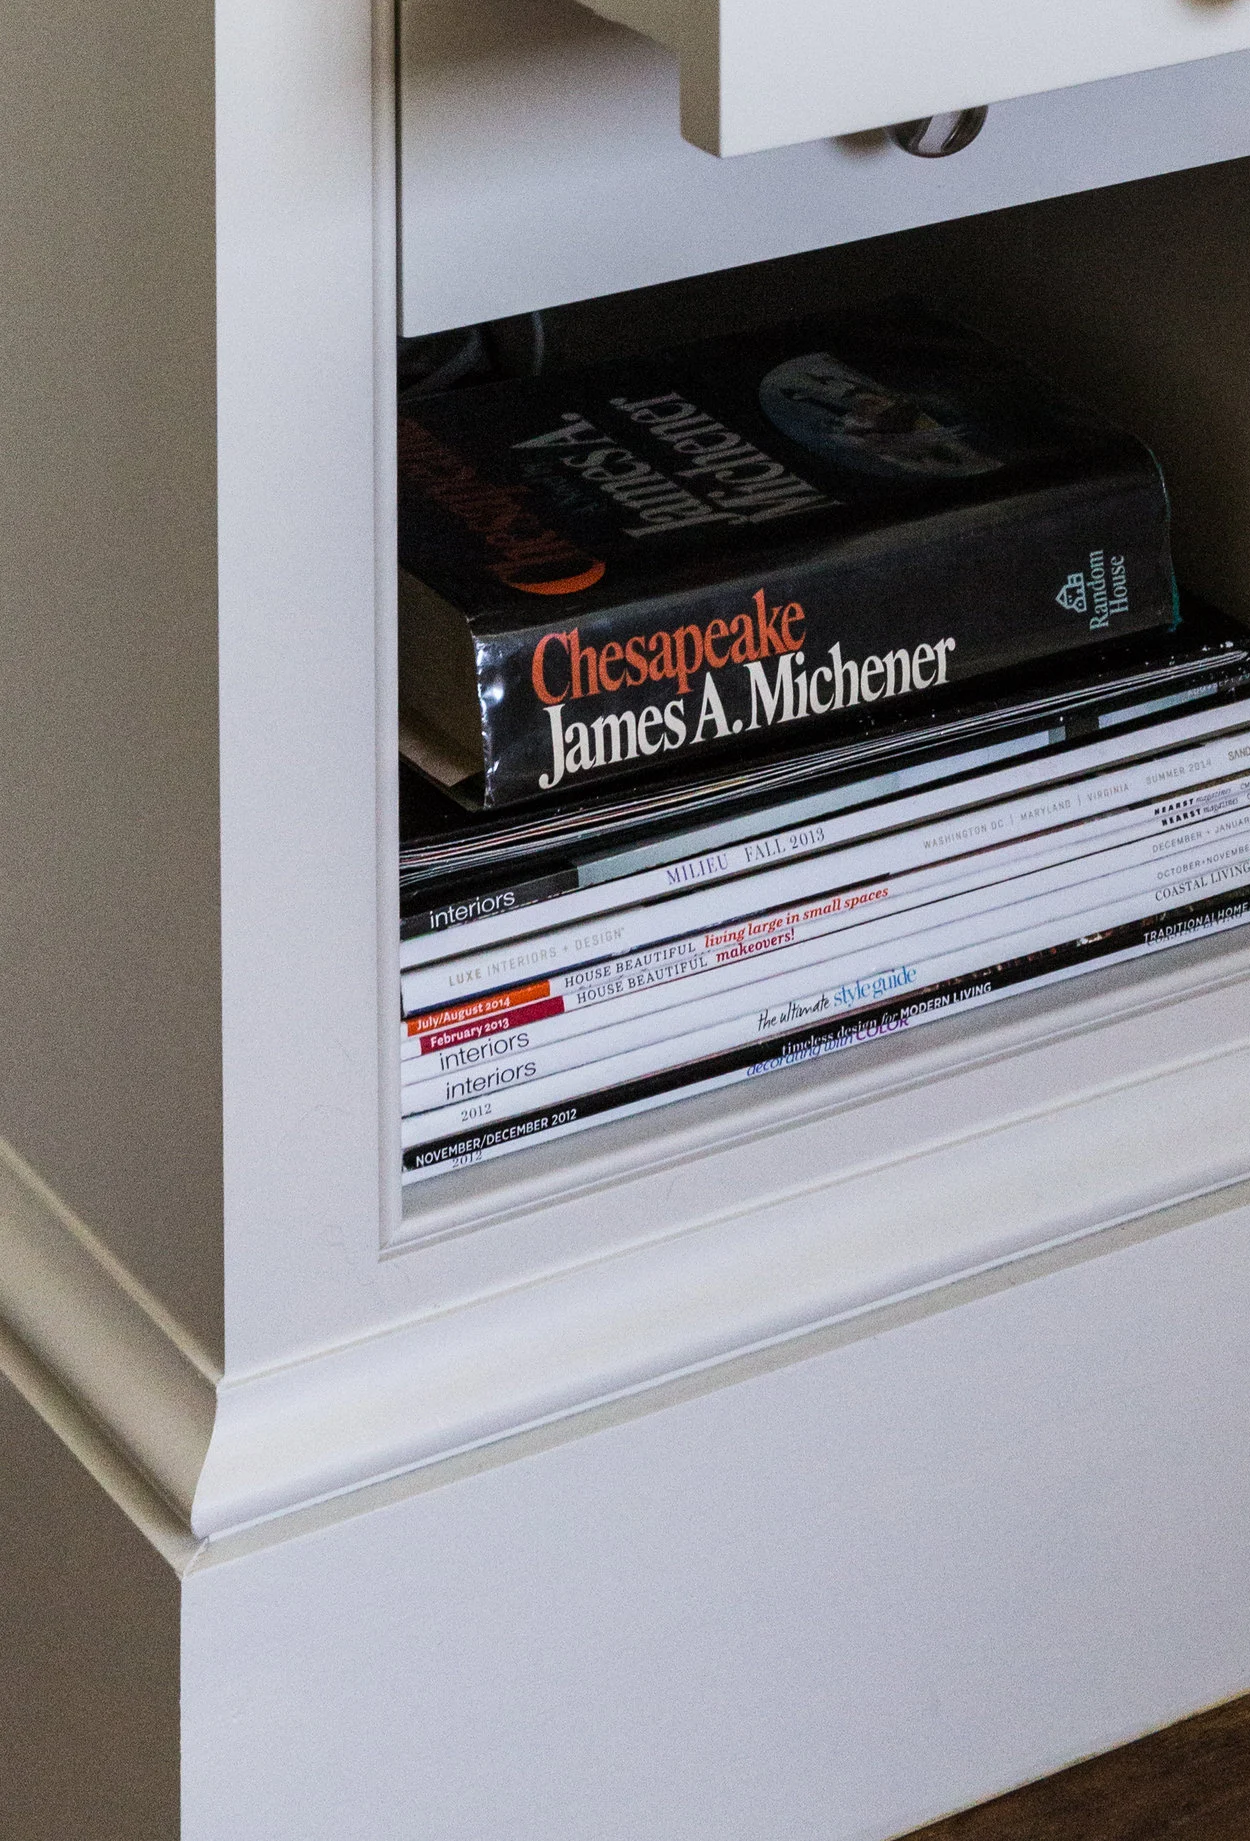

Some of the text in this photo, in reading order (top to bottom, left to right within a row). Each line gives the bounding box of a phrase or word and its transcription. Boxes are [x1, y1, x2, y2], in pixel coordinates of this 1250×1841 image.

[563, 447, 750, 539] James
[1087, 549, 1109, 631] Random
[1108, 555, 1130, 615] House
[531, 588, 806, 705] Chesapeake
[538, 636, 956, 790] James A. Michener
[922, 824, 988, 850] WASHINGTON
[991, 818, 1005, 831] DC
[1020, 799, 1072, 822] MARYLAND
[1087, 782, 1130, 803] VIRGINIA
[1146, 765, 1187, 786] SUMMER
[1187, 758, 1213, 774] 2014
[1155, 798, 1195, 816] HEARST
[1196, 787, 1233, 803] magazines
[1162, 808, 1201, 827] HEARST
[666, 827, 826, 886] MILIEU FALL 2013
[1152, 831, 1201, 854] DECEMBER
[429, 890, 516, 928] interiors
[1155, 876, 1209, 902] COASTAL
[448, 968, 482, 988] LUXE
[487, 947, 557, 978] INTERIORS
[564, 887, 889, 989] HOUSE BEAUTIFUL living large in small spaces
[577, 928, 796, 1004] HOUSE BEAUTIFUL makeovers!
[416, 996, 511, 1032] July/August 2014
[430, 1017, 511, 1049] February 2013
[415, 1116, 549, 1168] NOVEMBER/DECEMBER
[551, 1108, 578, 1126] 2012
[782, 1031, 835, 1057] timeless
[837, 1020, 878, 1041] design
[880, 1011, 901, 1030] for
[900, 994, 951, 1019] MODERN
[953, 981, 993, 1003] LIVING
[439, 1031, 531, 1072] interiors
[445, 1061, 537, 1101] interiors
[460, 1103, 493, 1123] 2012
[758, 1008, 778, 1032] the
[779, 994, 831, 1022] ultimate
